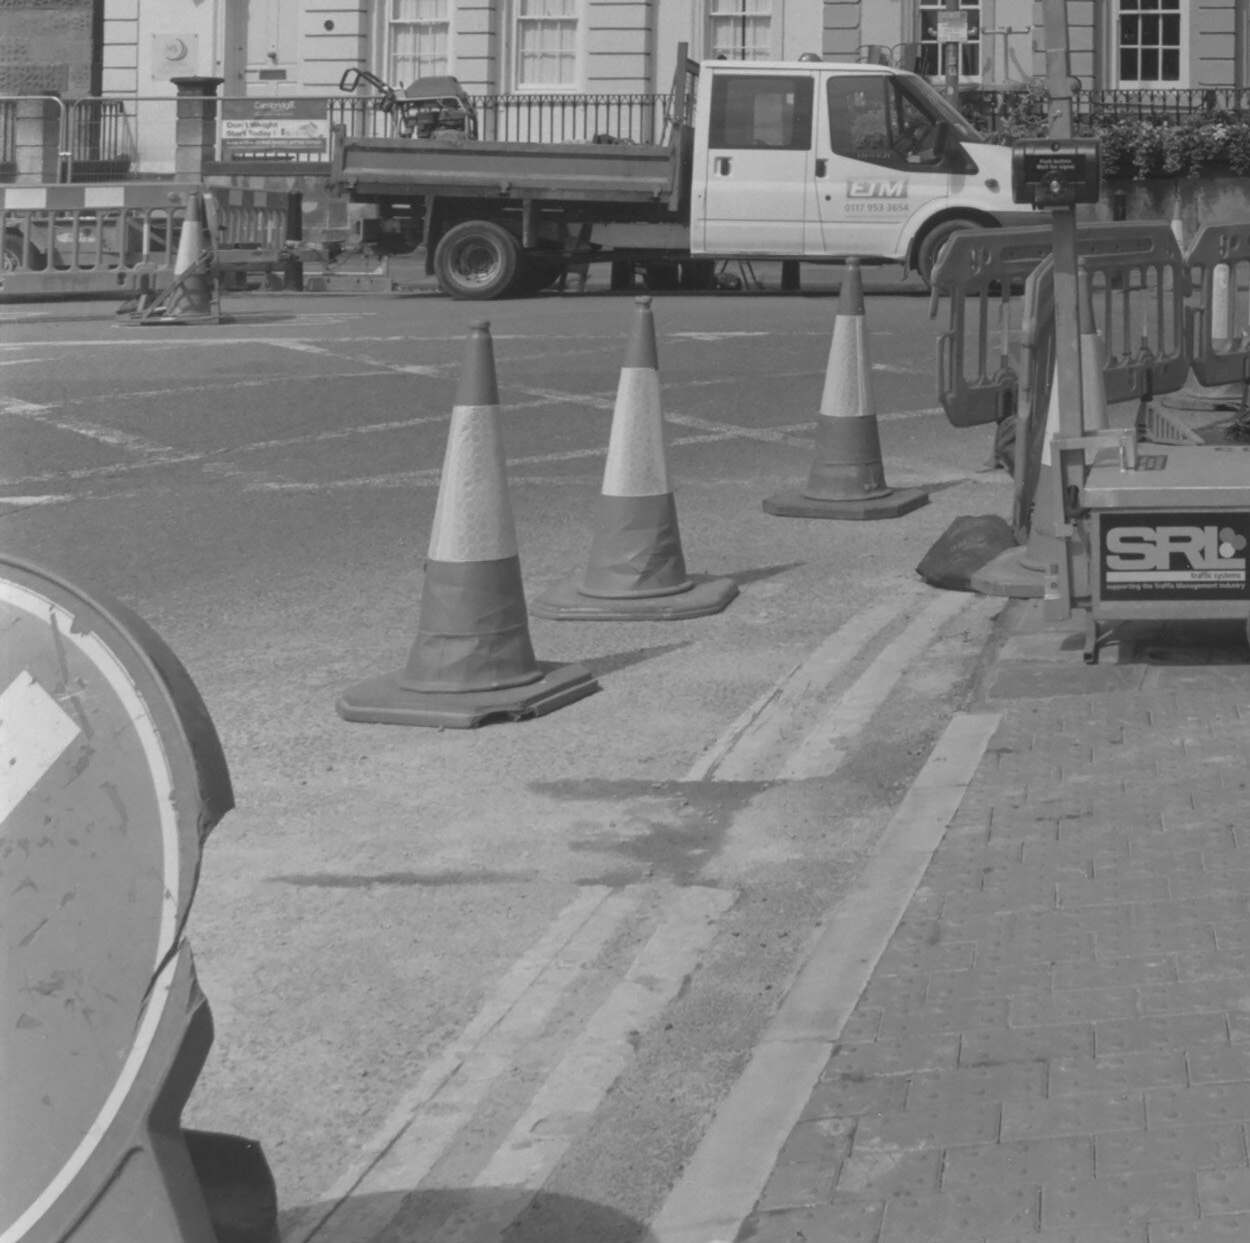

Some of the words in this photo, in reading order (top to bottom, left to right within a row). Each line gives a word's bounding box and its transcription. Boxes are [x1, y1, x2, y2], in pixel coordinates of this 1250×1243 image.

[849, 181, 904, 197] ETM
[844, 204, 865, 212] 0117
[867, 204, 884, 212] 953
[886, 204, 909, 212] 3654
[1106, 525, 1246, 570] SRL
[1213, 572, 1242, 581] systems
[1106, 582, 1142, 591] supporting
[1175, 582, 1218, 591] Management
[1219, 581, 1246, 590] industry
